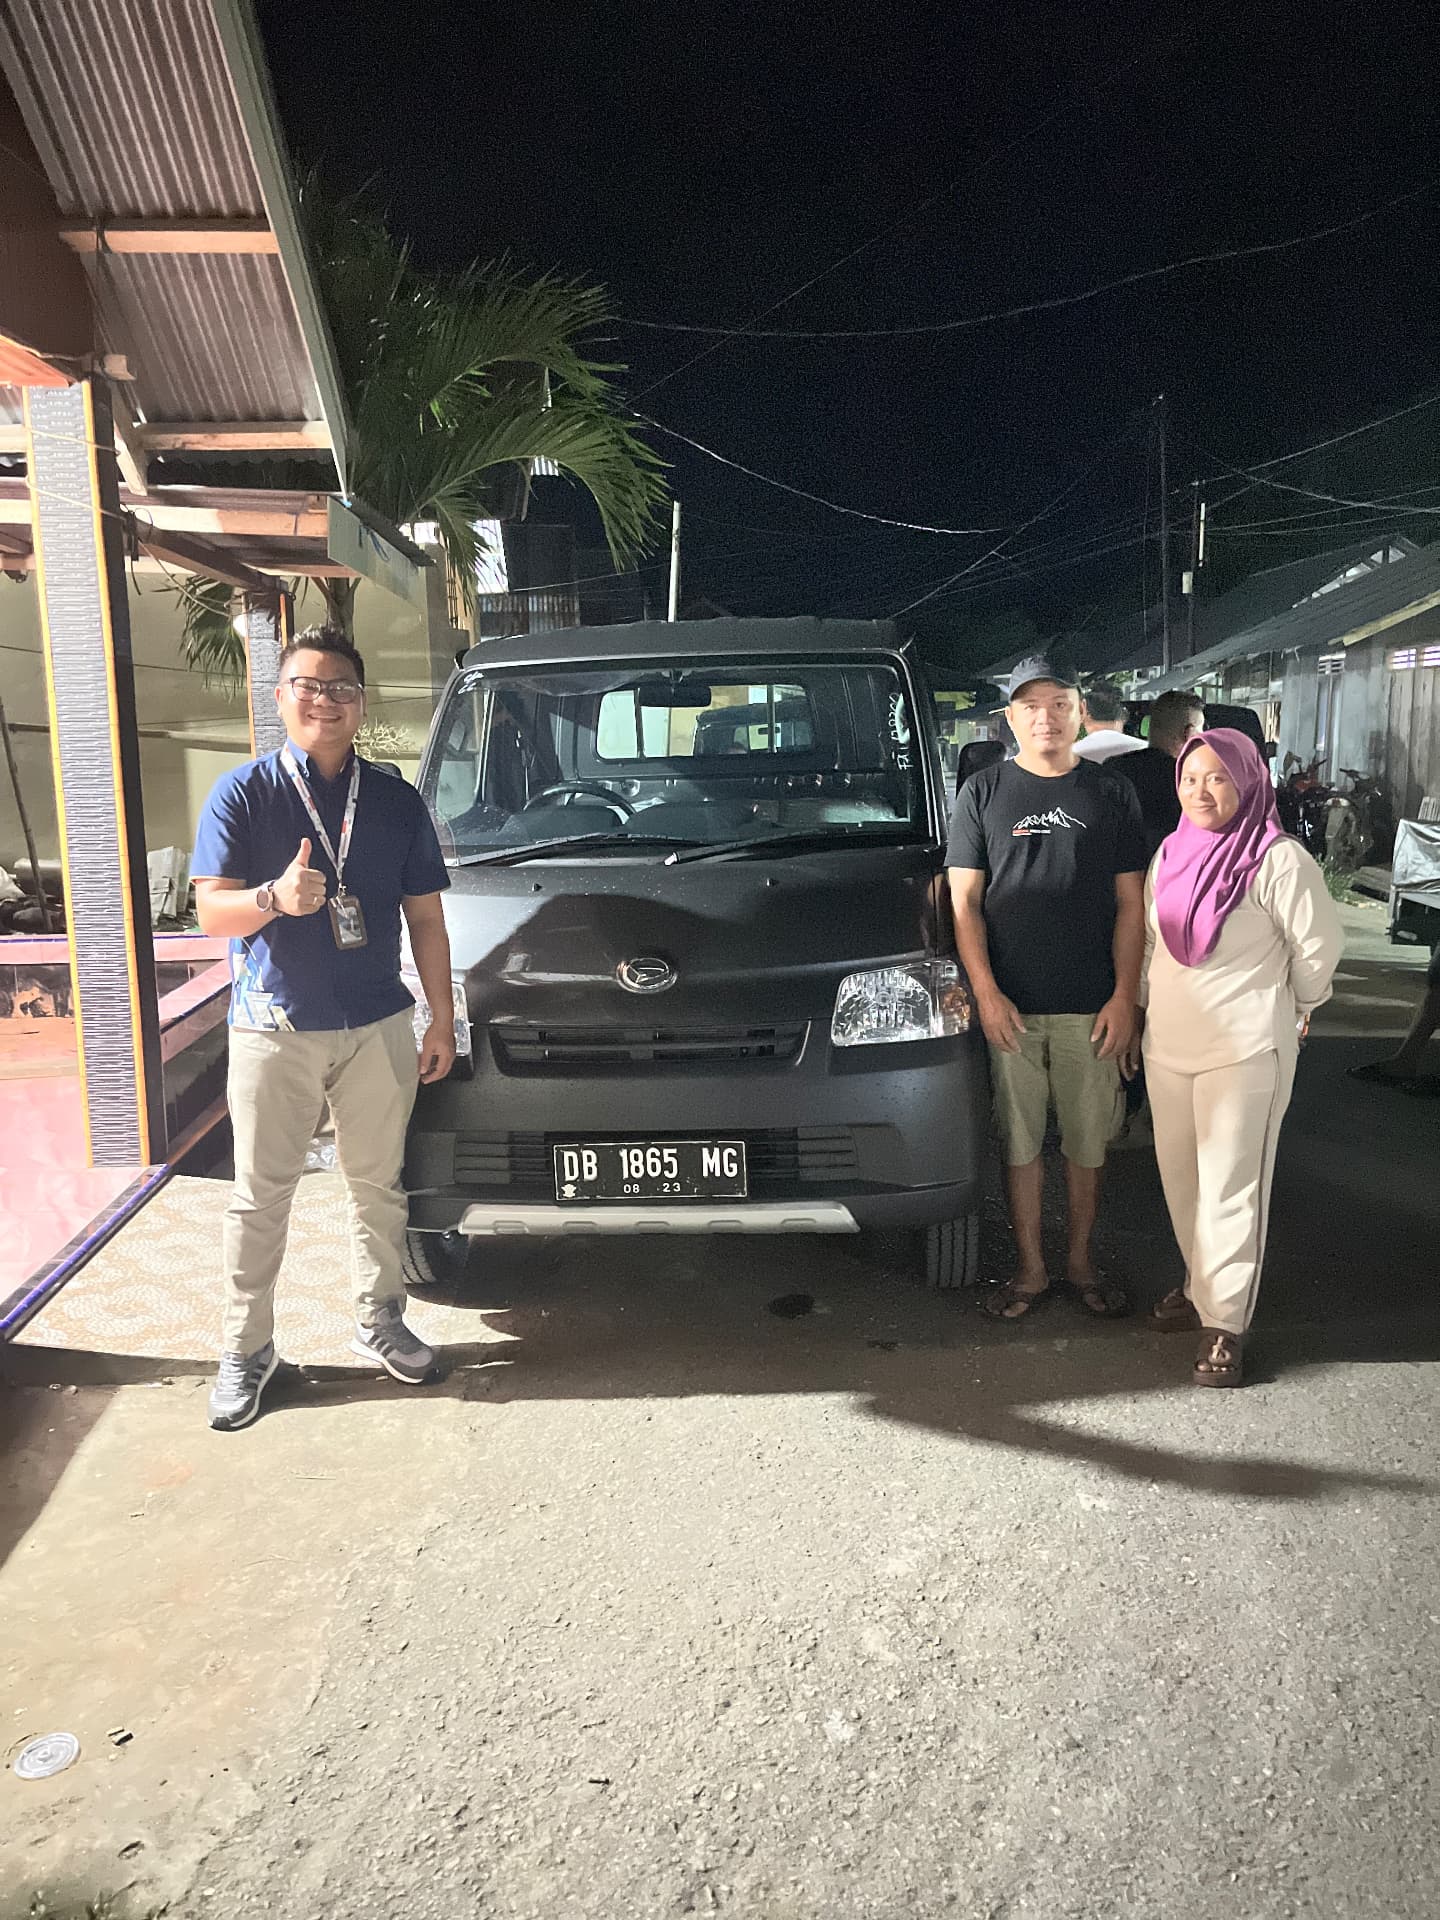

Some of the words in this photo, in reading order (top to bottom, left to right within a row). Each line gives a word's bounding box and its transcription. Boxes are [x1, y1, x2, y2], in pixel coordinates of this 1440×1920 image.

[563, 1151, 597, 1181] DB
[619, 1148, 677, 1179] 1865
[702, 1147, 737, 1177] MG
[624, 1184, 639, 1193] 08
[663, 1183, 680, 1192] 23
